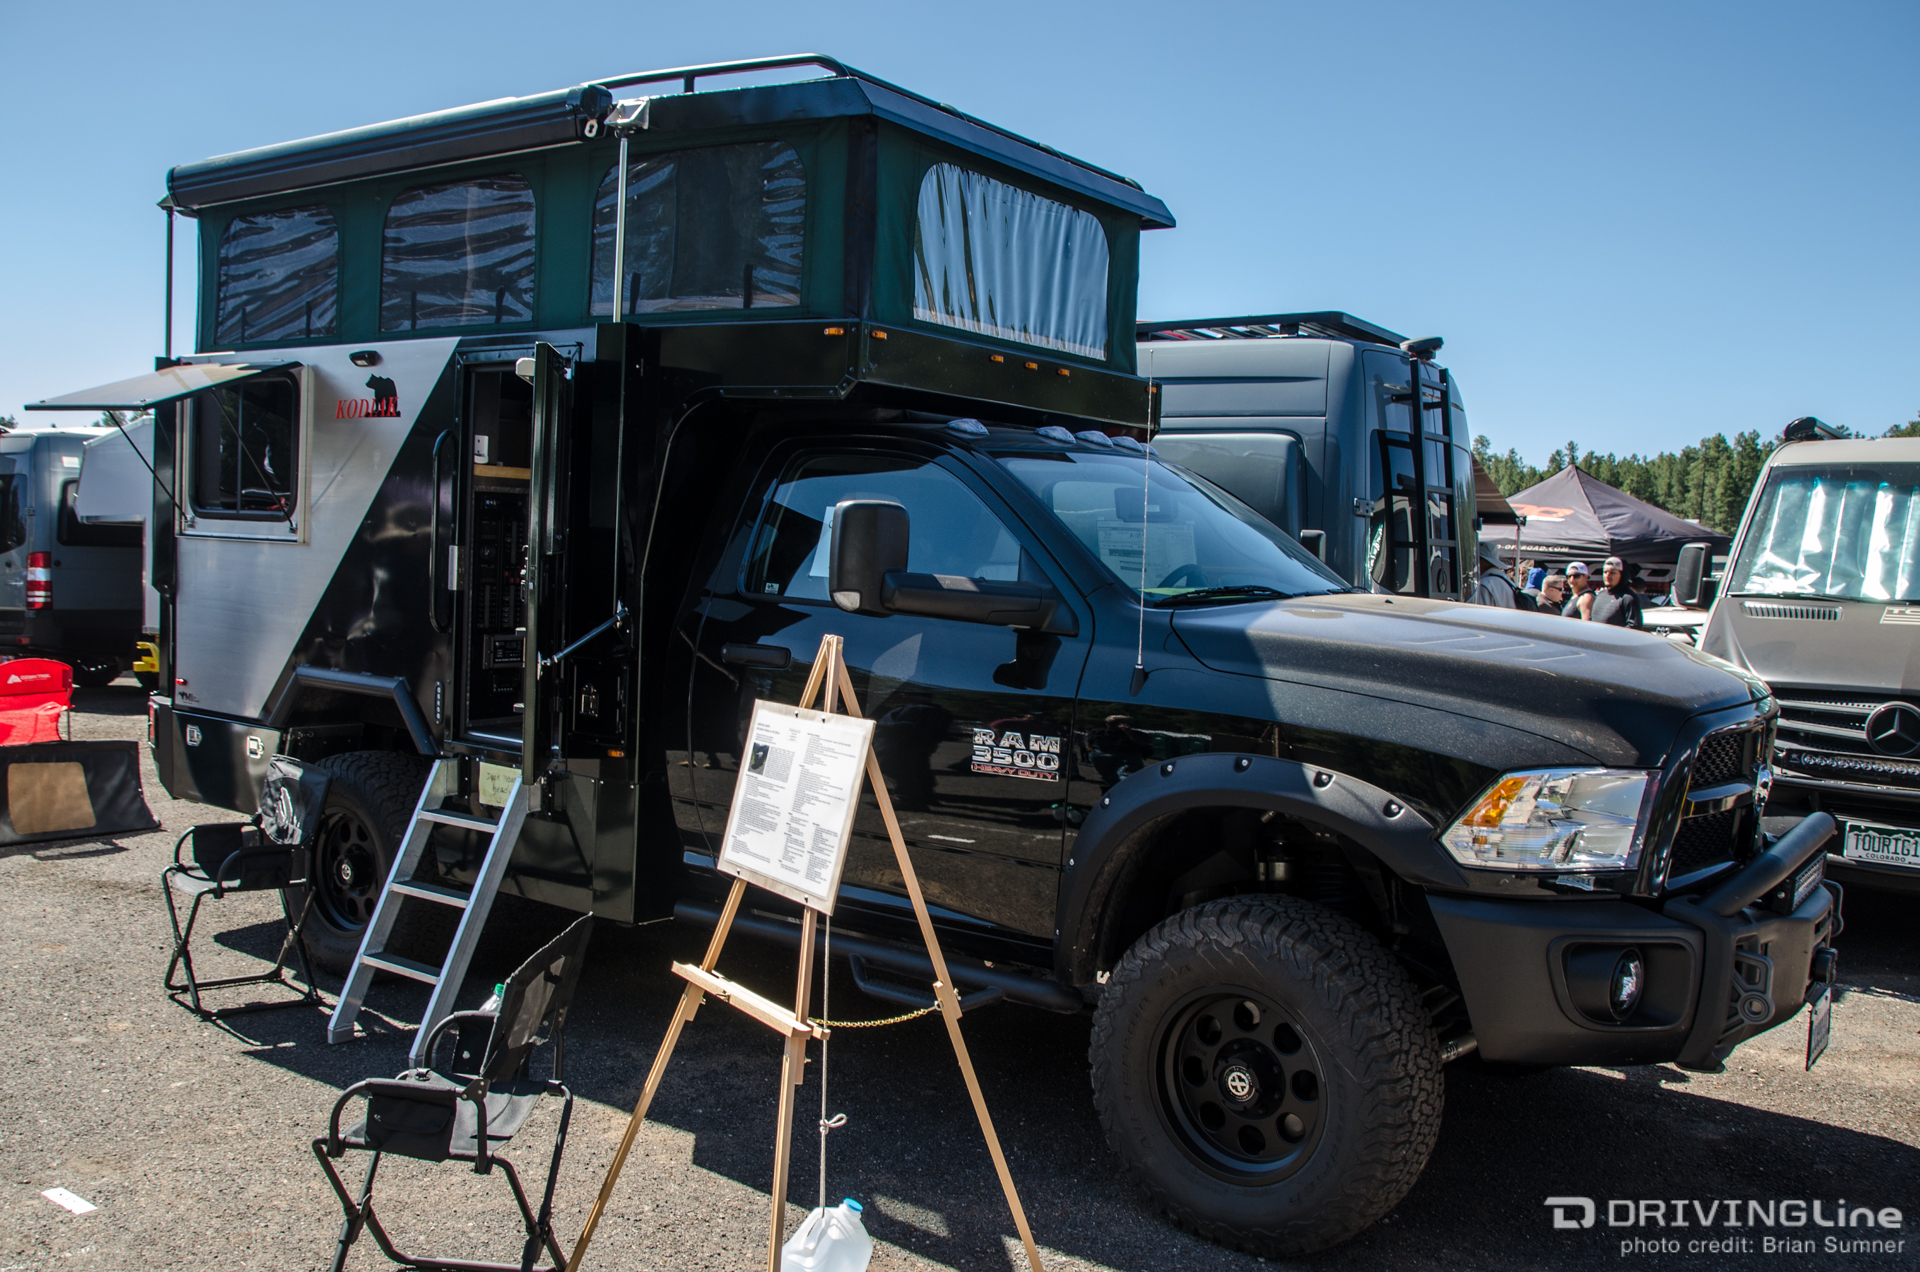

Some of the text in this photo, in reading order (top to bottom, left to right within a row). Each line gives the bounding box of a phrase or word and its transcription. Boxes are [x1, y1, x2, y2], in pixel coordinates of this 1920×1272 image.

[335, 397, 399, 419] KODIAK
[973, 727, 1061, 753] RAM
[972, 744, 1060, 771] 3500
[974, 763, 1055, 779] HEAVY DUTY
[1853, 833, 1920, 858] TOURIG1
[1865, 852, 1906, 863] COLORADO
